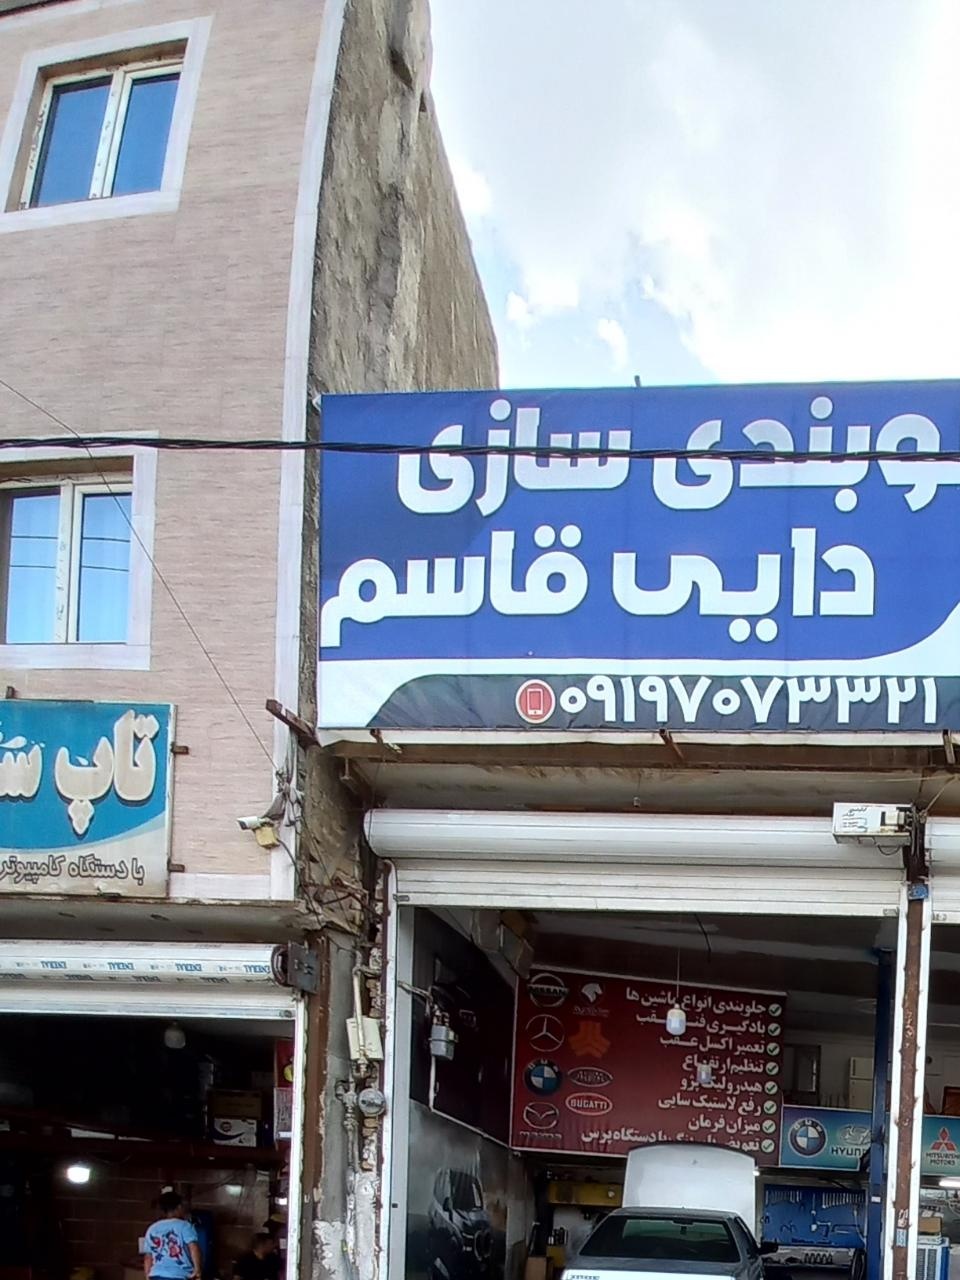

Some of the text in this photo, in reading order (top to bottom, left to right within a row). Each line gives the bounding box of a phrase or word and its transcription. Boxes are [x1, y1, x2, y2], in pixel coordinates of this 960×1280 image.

[398, 398, 632, 518] سازی
[319, 523, 590, 649] قاسم
[68, 853, 129, 880] دستگاه
[131, 857, 146, 887] با
[626, 987, 640, 1001] ها
[681, 994, 713, 1012] انواع
[713, 1000, 767, 1018] جلوبندی
[699, 1035, 733, 1052] اکسل
[734, 1041, 765, 1056] تعمیر
[571, 1099, 608, 1110] BUGATTI
[738, 1098, 762, 1116] رفع
[688, 1114, 761, 1135] میزان فرمان
